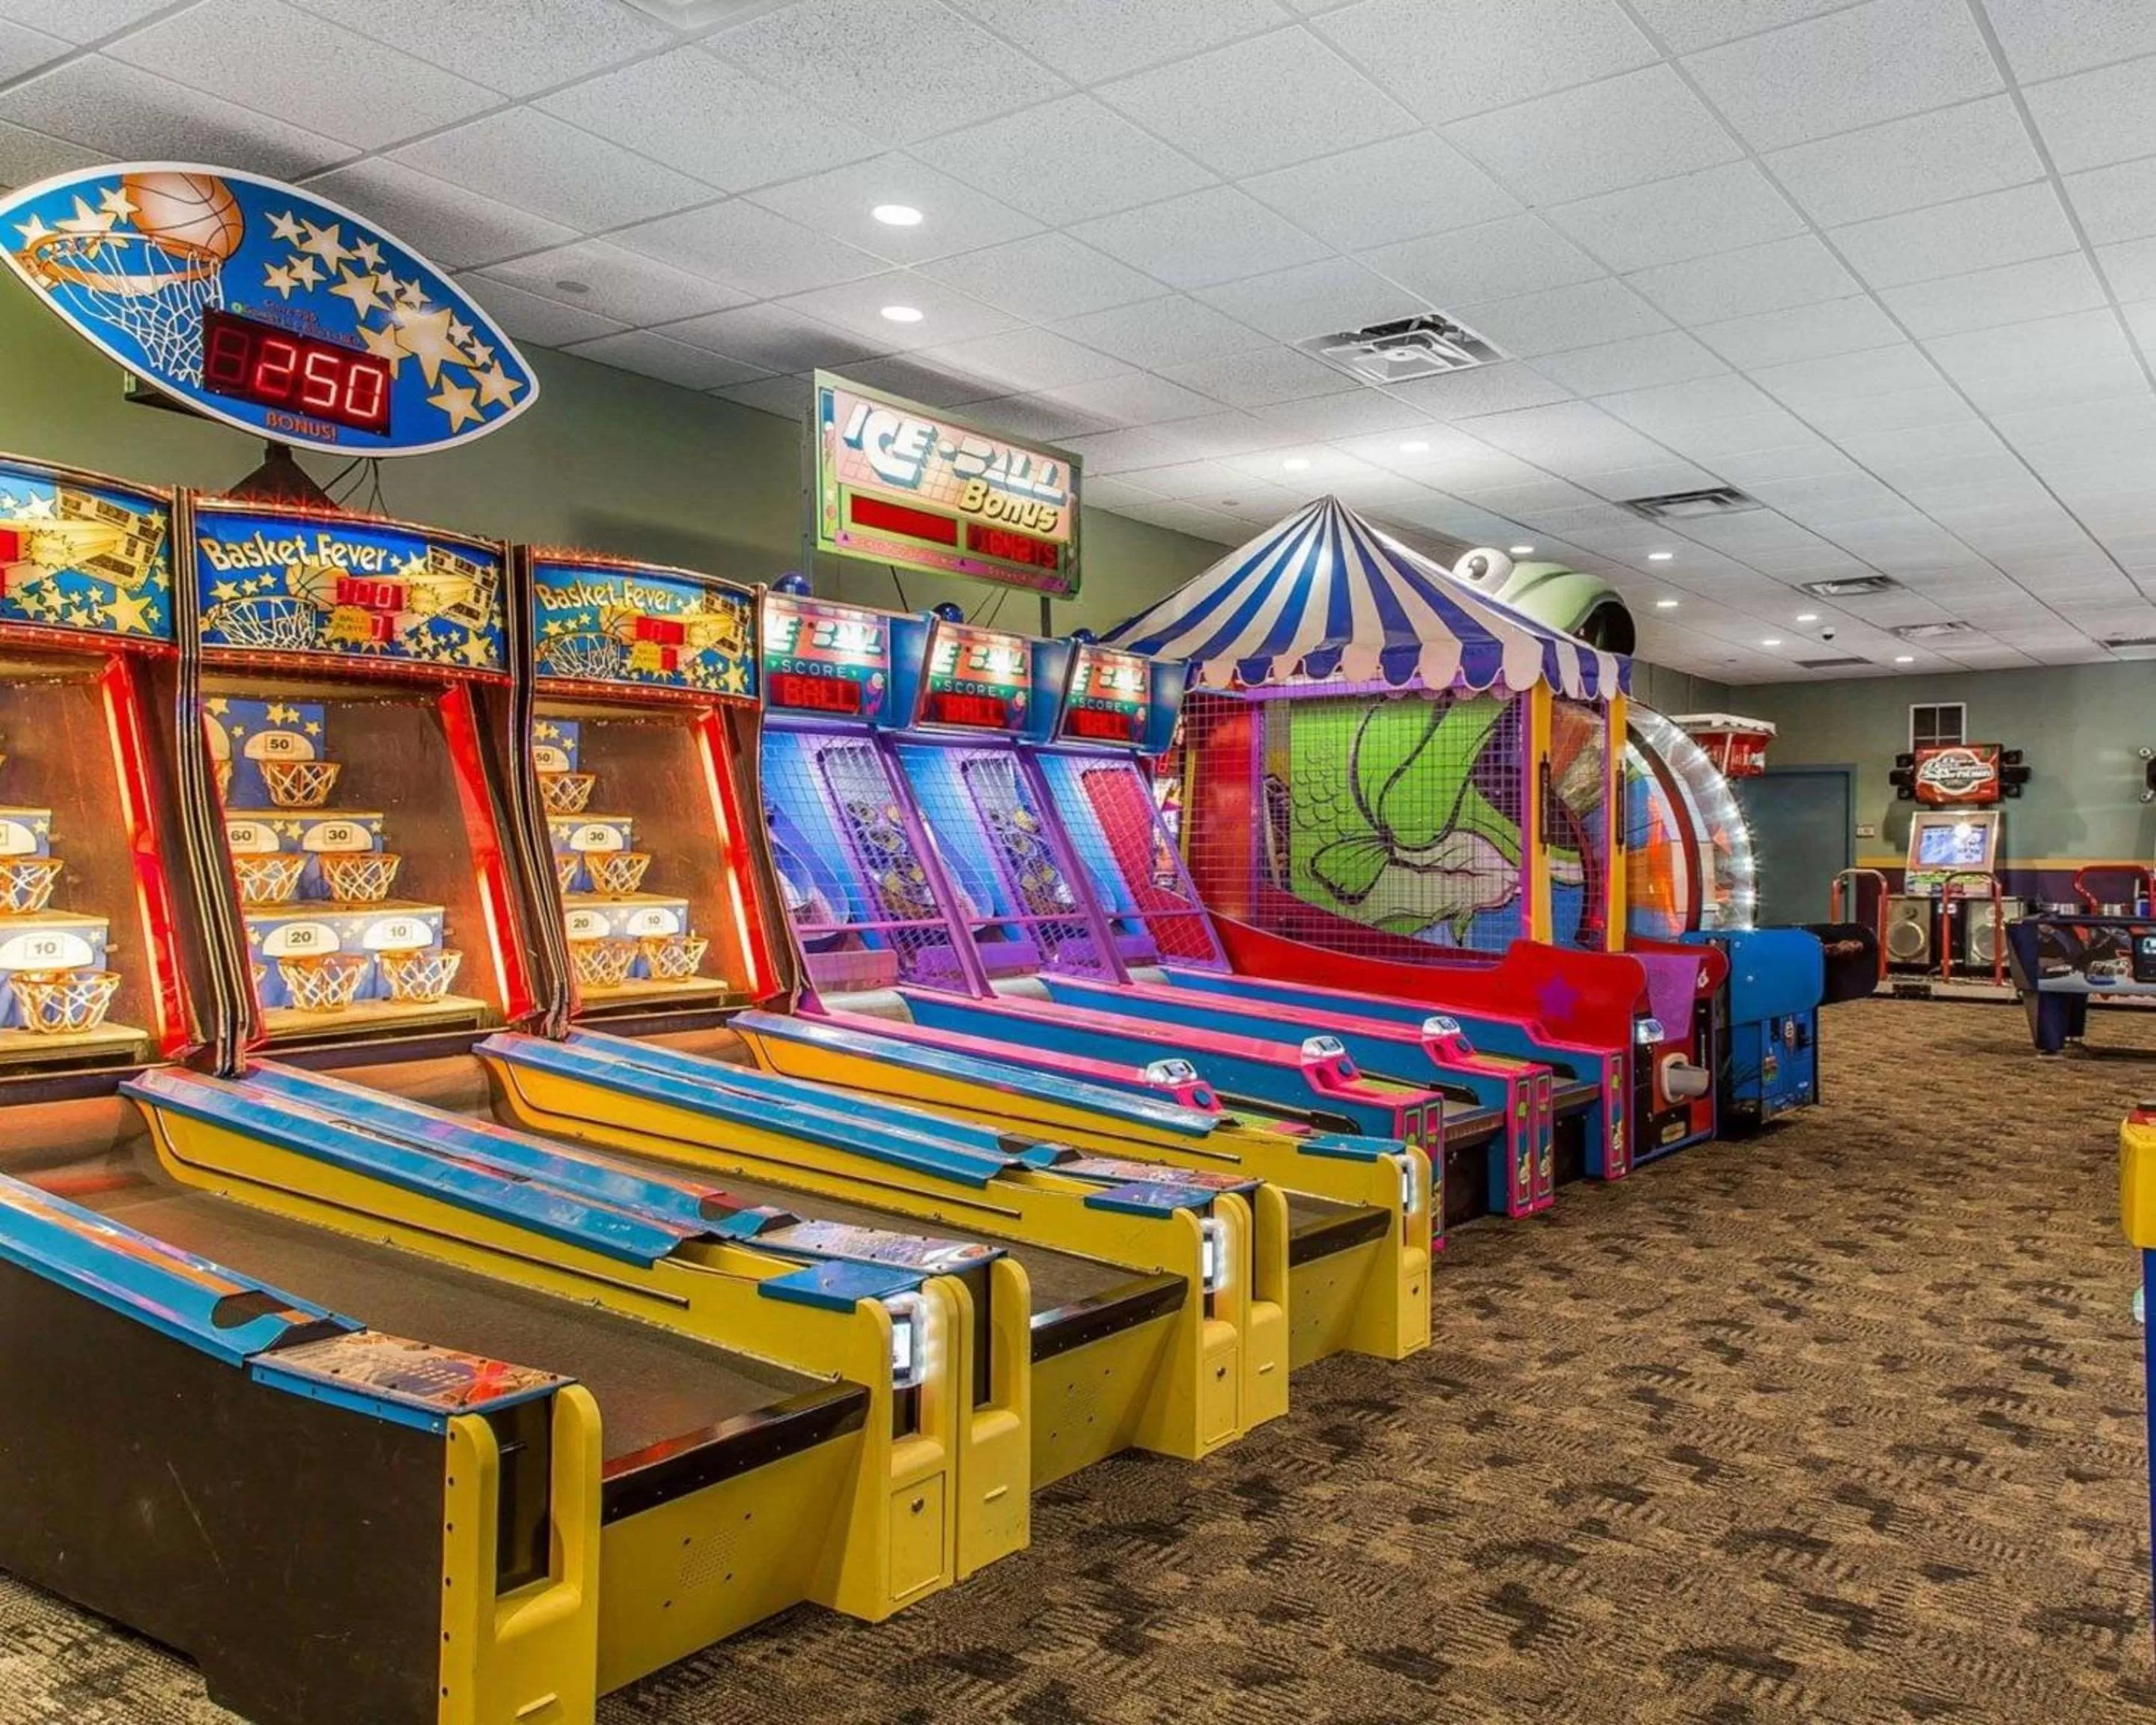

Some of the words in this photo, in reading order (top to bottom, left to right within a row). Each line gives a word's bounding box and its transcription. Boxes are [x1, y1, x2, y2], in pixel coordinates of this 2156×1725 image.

[255, 340, 383, 418] 250
[267, 411, 335, 443] BONUS!
[959, 477, 1059, 533] Bonus
[198, 531, 310, 571] Basket
[311, 533, 388, 572] Fever
[536, 579, 618, 611] Basket
[621, 578, 672, 611] Fever
[781, 659, 847, 679] SCORE
[944, 680, 996, 696] SCORE
[1079, 696, 1122, 713] SCORE
[270, 739, 289, 750] 50
[535, 752, 550, 762] 50
[231, 830, 252, 841] 60
[328, 830, 348, 841] 30
[590, 831, 604, 841] 30
[574, 919, 589, 928] 20
[648, 916, 660, 925] 10
[290, 931, 312, 943] 20
[390, 926, 406, 937] 10
[34, 942, 56, 955] 10
